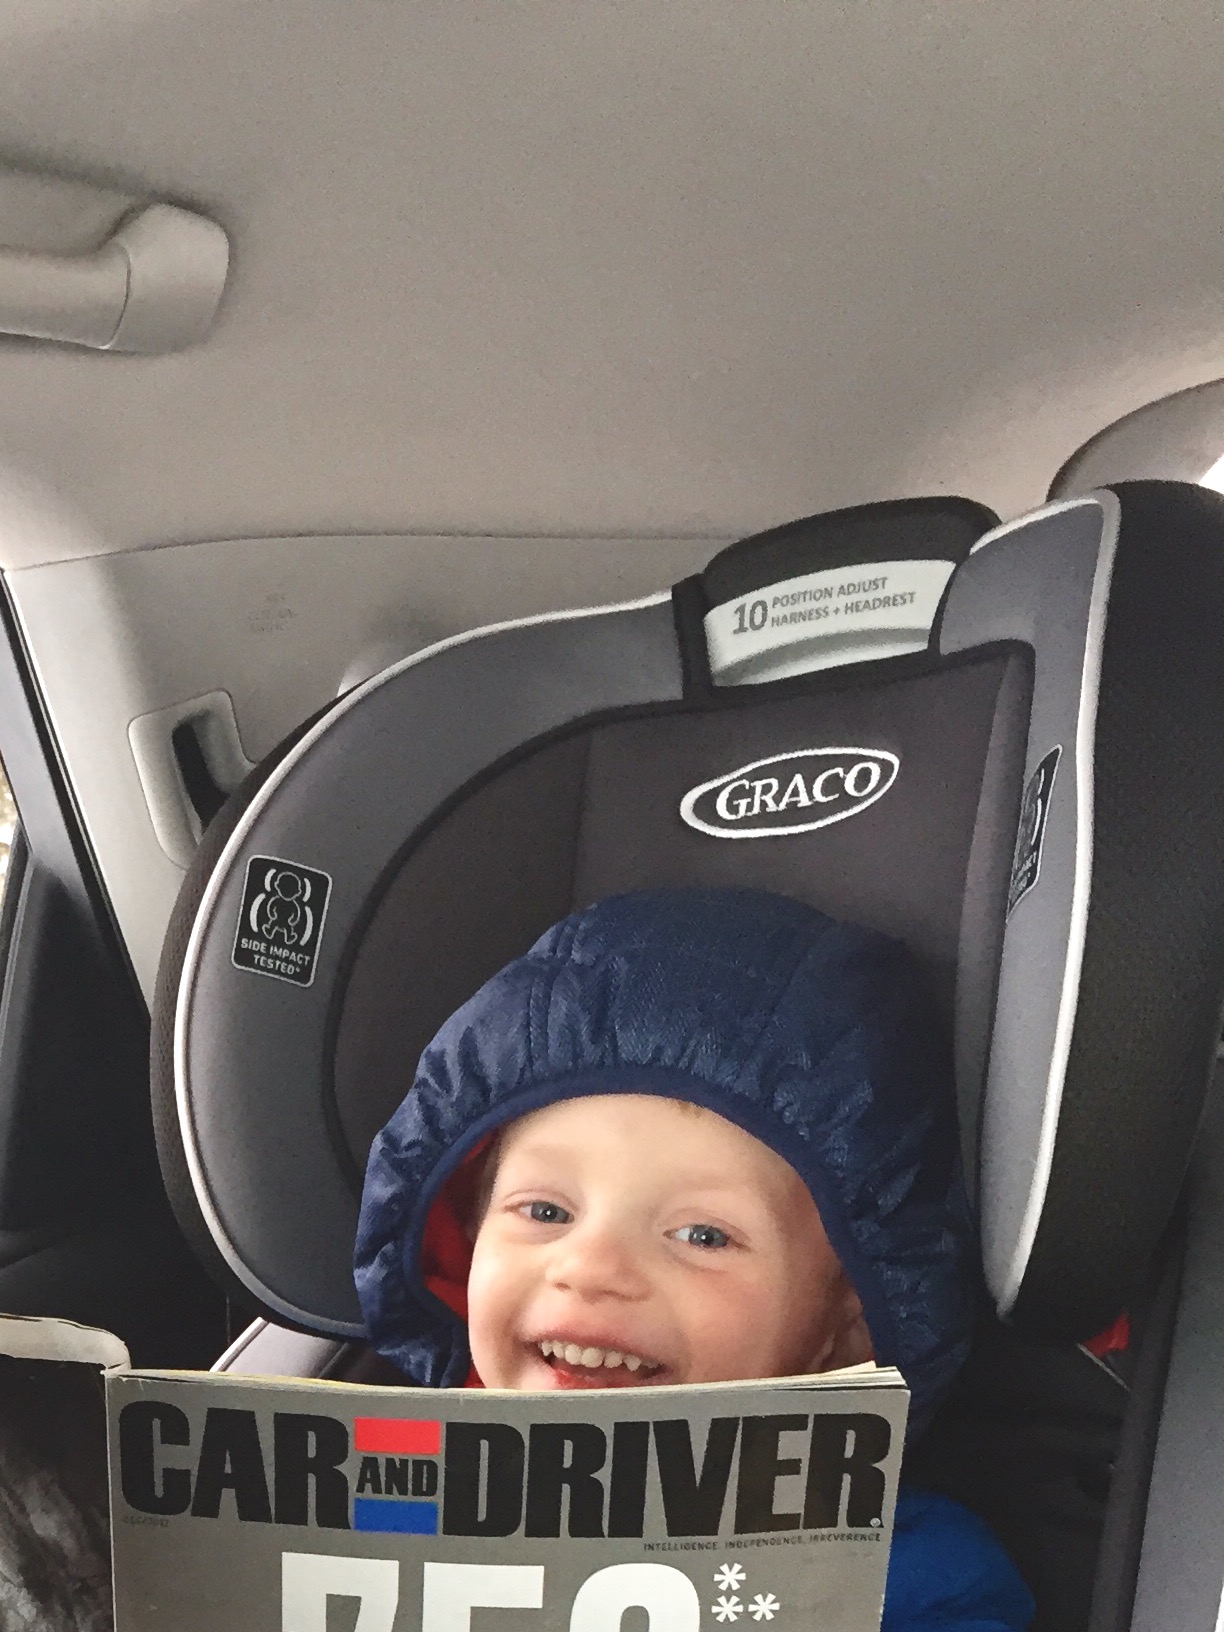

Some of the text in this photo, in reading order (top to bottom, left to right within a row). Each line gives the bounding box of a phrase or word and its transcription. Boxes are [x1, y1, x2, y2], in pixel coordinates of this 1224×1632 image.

[732, 576, 889, 635] 10 POSITION ADJUST
[770, 607, 830, 629] HARNESS
[844, 591, 917, 616] HEADREST
[715, 761, 882, 821] GRACO
[240, 937, 311, 967] SIDE IMPACT
[118, 1400, 893, 1539] CAR AND DRIVER
